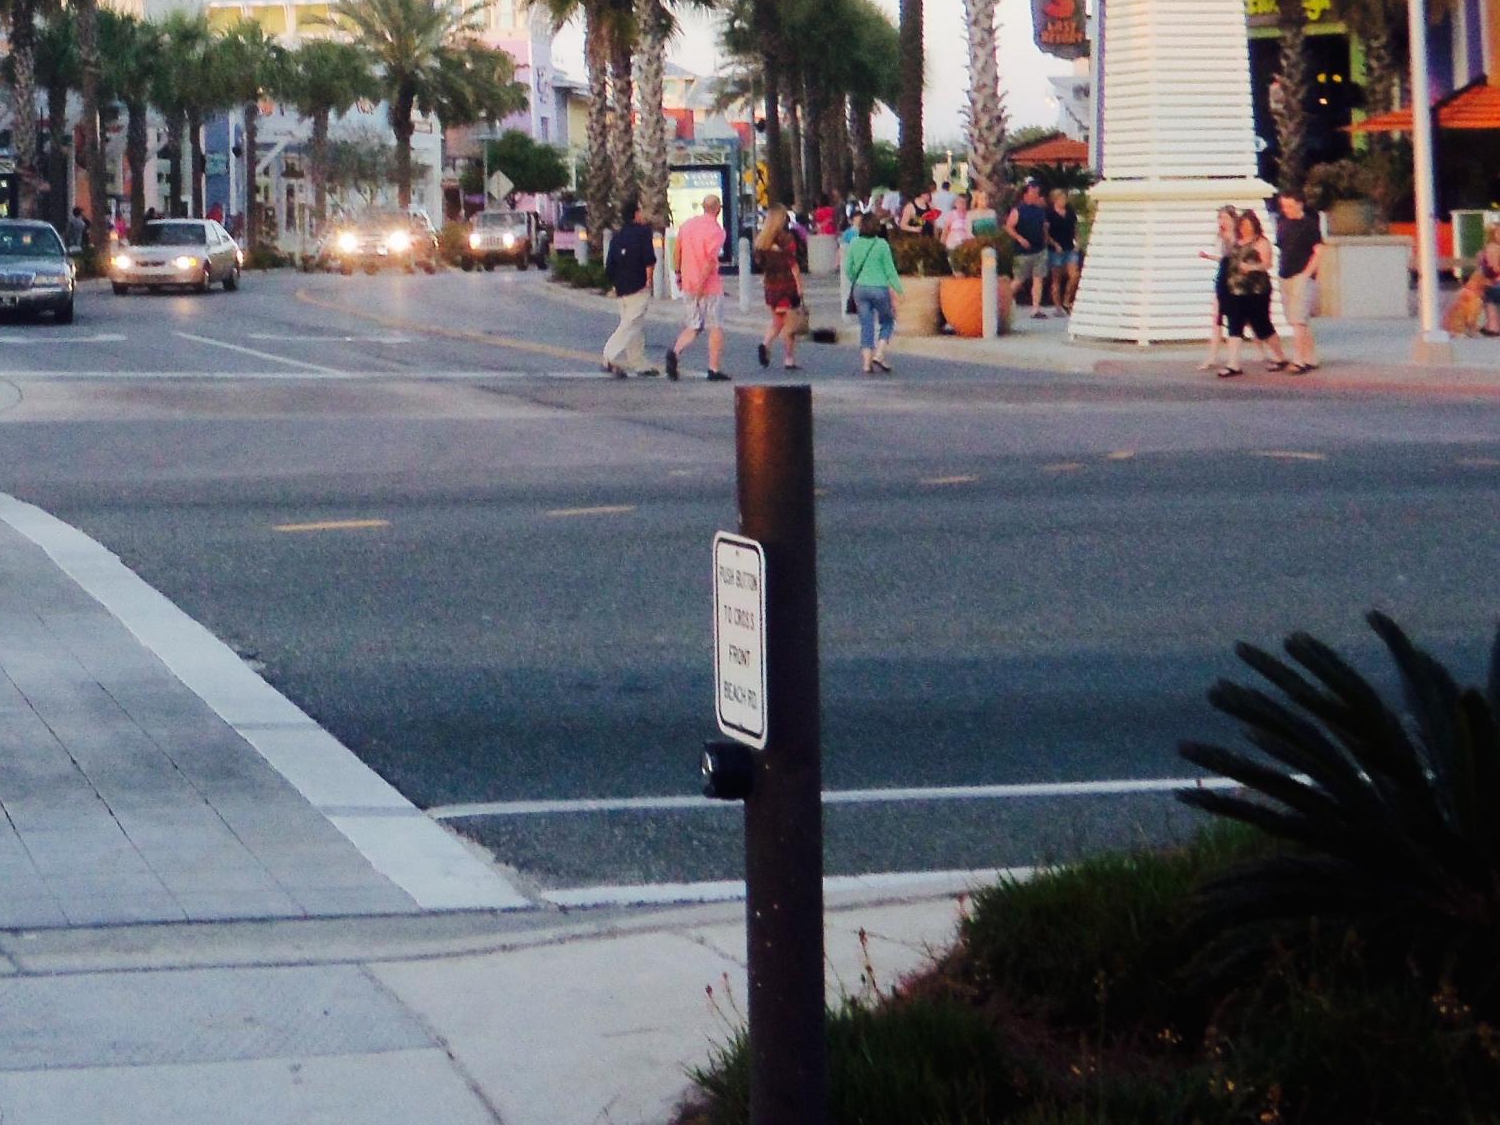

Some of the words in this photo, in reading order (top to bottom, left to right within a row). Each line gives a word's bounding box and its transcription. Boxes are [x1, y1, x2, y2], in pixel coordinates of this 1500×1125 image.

[719, 565, 735, 585] PUSH
[735, 569, 758, 592] BUTTON
[723, 604, 732, 624] TO
[734, 607, 755, 631] CROSS
[728, 643, 751, 668] FRONT
[723, 680, 747, 705] BEACH
[747, 688, 758, 710] RD
